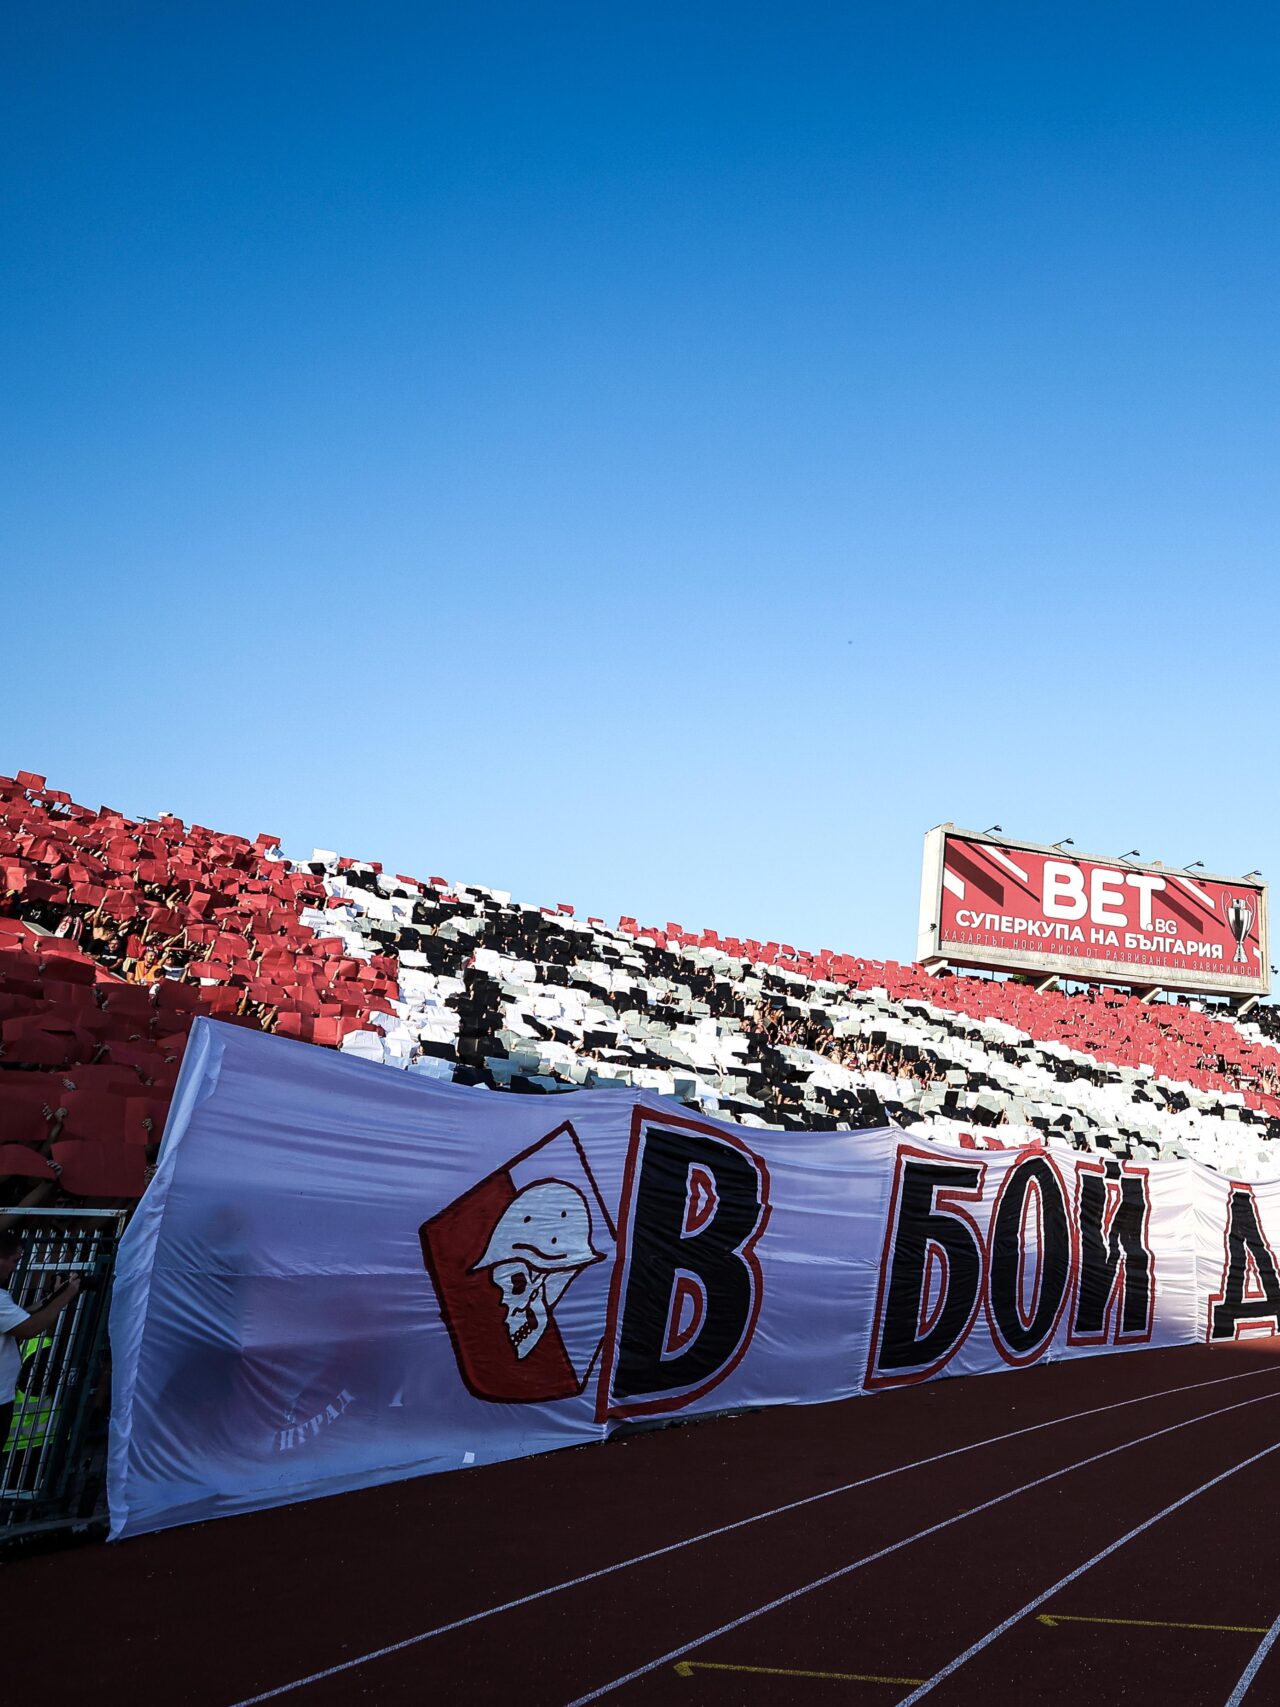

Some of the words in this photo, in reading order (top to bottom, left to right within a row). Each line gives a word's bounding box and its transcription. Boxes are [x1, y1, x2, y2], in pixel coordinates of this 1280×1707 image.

[943, 928, 1005, 946] ХАЗАРТЪТ
[1013, 938, 1043, 951] НОСИ
[1050, 943, 1079, 956] РИСК
[1086, 947, 1099, 958] ОТ
[1105, 950, 1168, 966] РАЗВИВАНЕ
[1174, 957, 1187, 969] НА
[1192, 961, 1259, 976] ЗАВИСИМОСТ
[955, 909, 1085, 942] СУПЕРКУПА
[1091, 928, 1119, 948] НА
[1124, 933, 1223, 960] БЪЛГАРИЯ
[597, 1105, 772, 1424] В
[864, 1144, 1157, 1389] БОЙ
